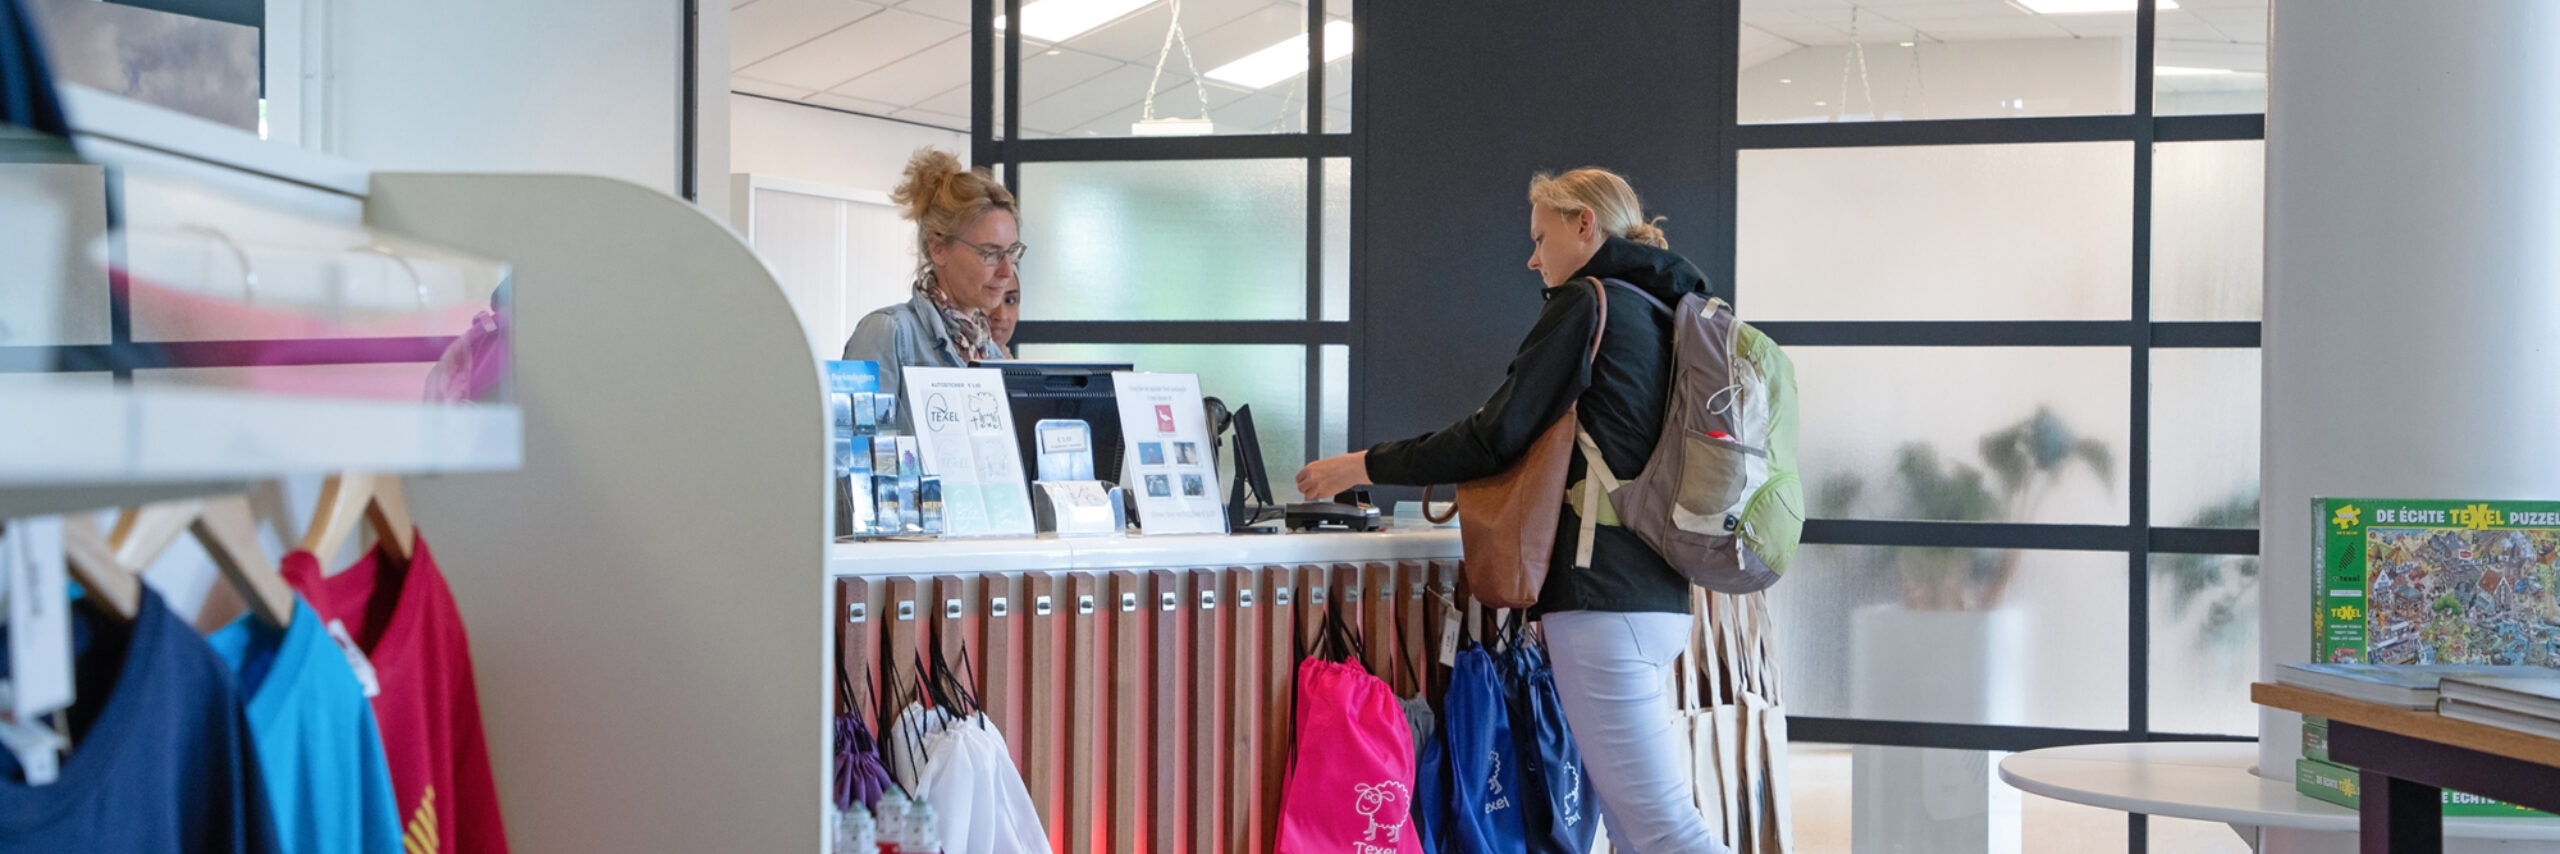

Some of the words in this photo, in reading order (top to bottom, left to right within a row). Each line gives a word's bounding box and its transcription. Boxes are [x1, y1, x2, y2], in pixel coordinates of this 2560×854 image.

[931, 410, 960, 422] TEXEL
[2376, 509, 2395, 523] DE
[2399, 506, 2445, 523] ÉCHTE
[2450, 503, 2505, 530] TEXEL
[2509, 511, 2560, 525] PUZZEL
[2331, 605, 2362, 620] TEXEL
[1485, 796, 1510, 814] exel
